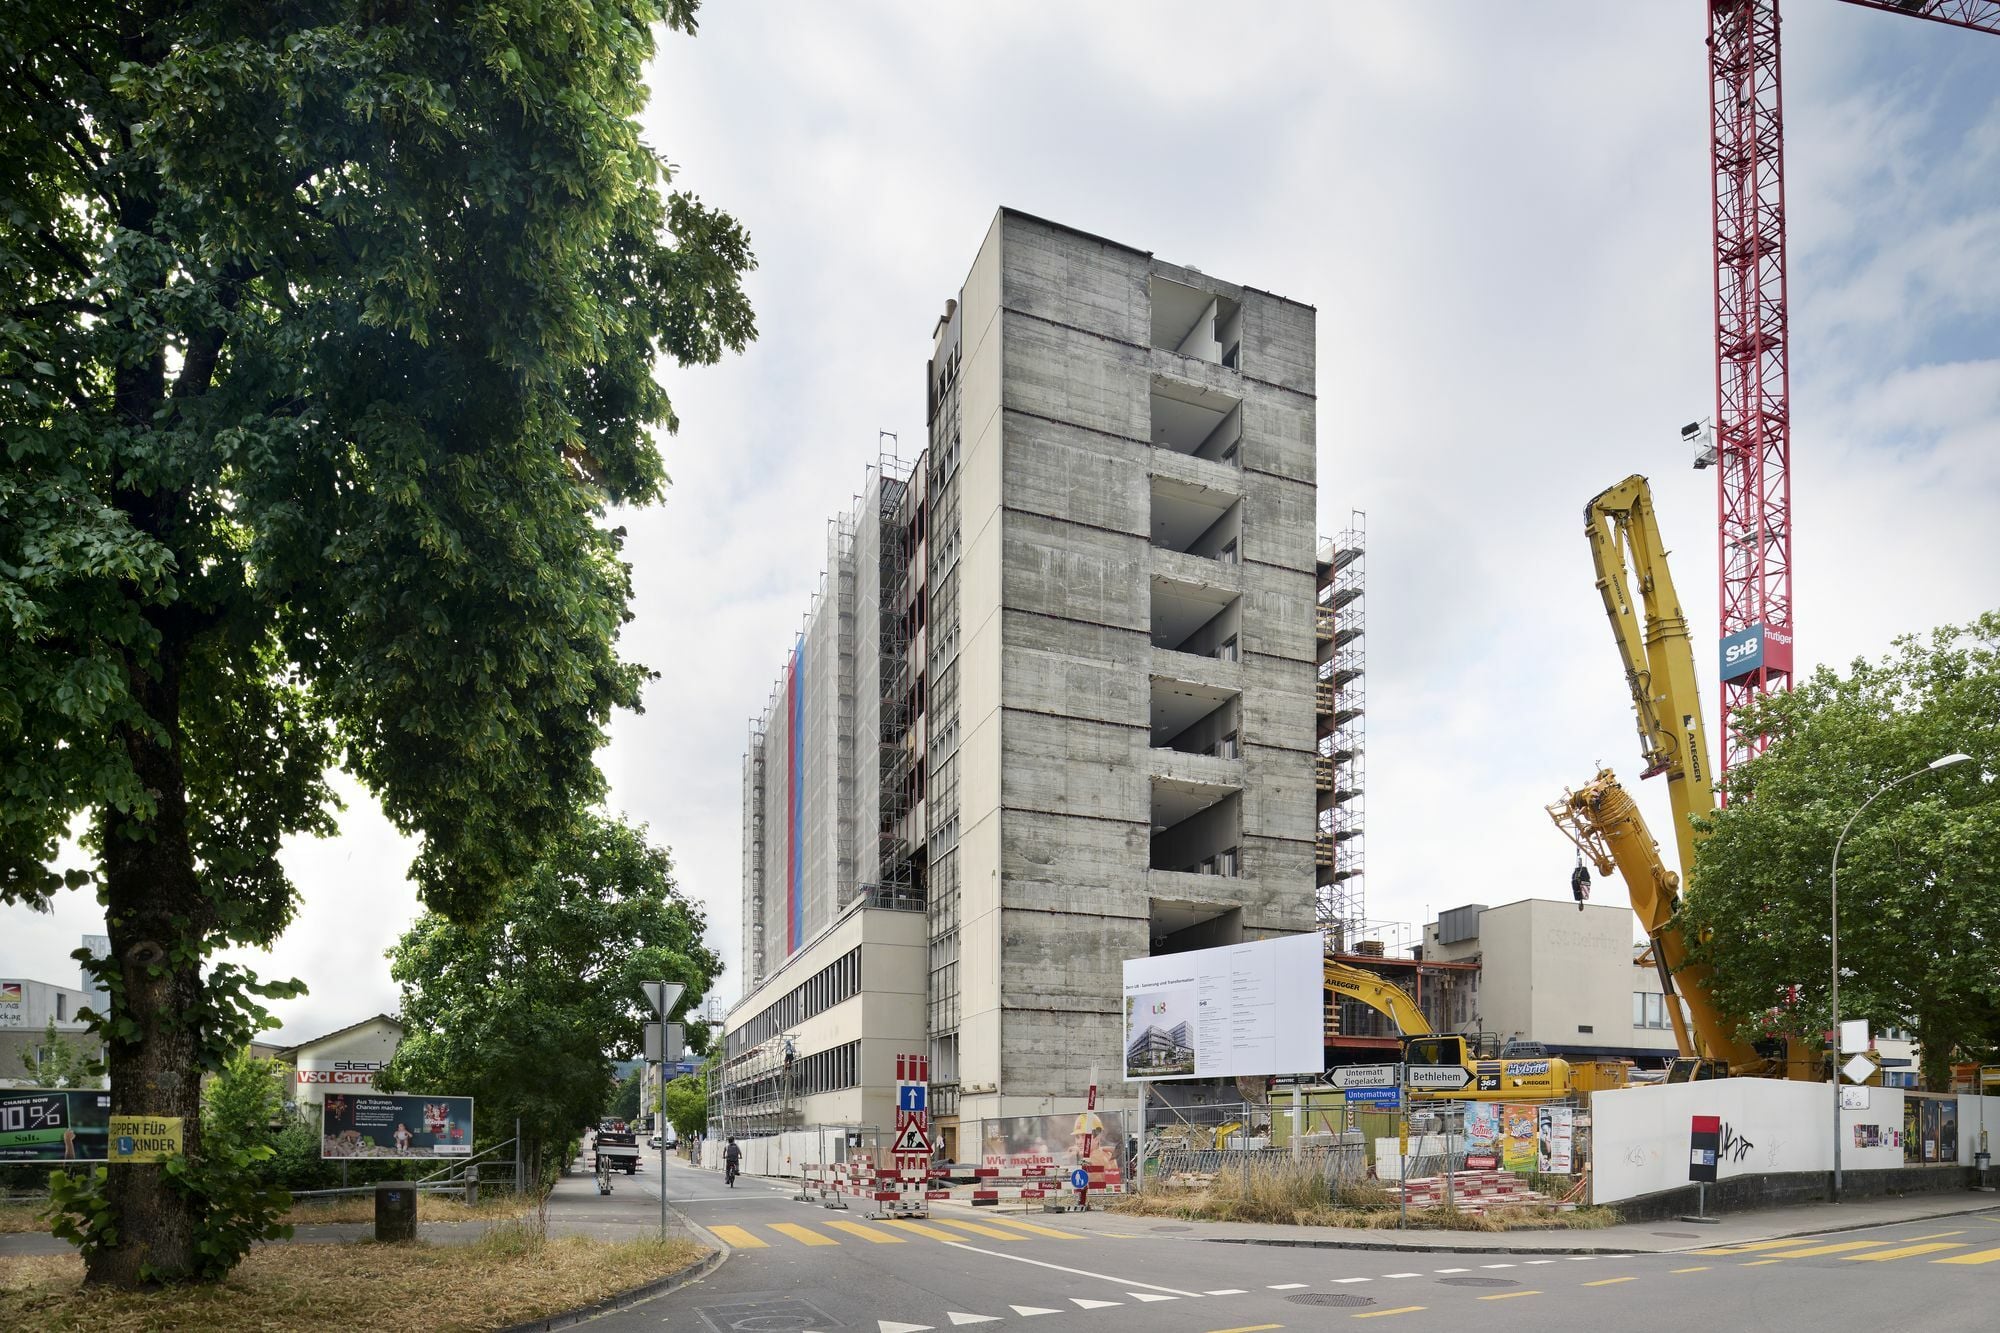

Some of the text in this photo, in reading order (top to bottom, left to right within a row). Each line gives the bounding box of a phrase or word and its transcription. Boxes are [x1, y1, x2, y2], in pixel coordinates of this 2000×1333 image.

[1764, 627, 1792, 645] Frutiger
[1725, 637, 1758, 662] S+B
[1688, 732, 1702, 783] AREGGER
[1325, 978, 1360, 991] AREGGER
[334, 1060, 390, 1071] steck
[1507, 1061, 1550, 1075] Hybrid
[299, 1071, 330, 1083] VSCI
[1345, 1069, 1383, 1077] Untermatt
[1413, 1072, 1461, 1082] Bethlehem
[1343, 1076, 1385, 1086] Ziegelacker
[1348, 1090, 1396, 1099] Untermattweg
[143, 1120, 167, 1135] FÜR
[15, 1134, 40, 1142] Salt.
[986, 1155, 1054, 1165] Wir machen
